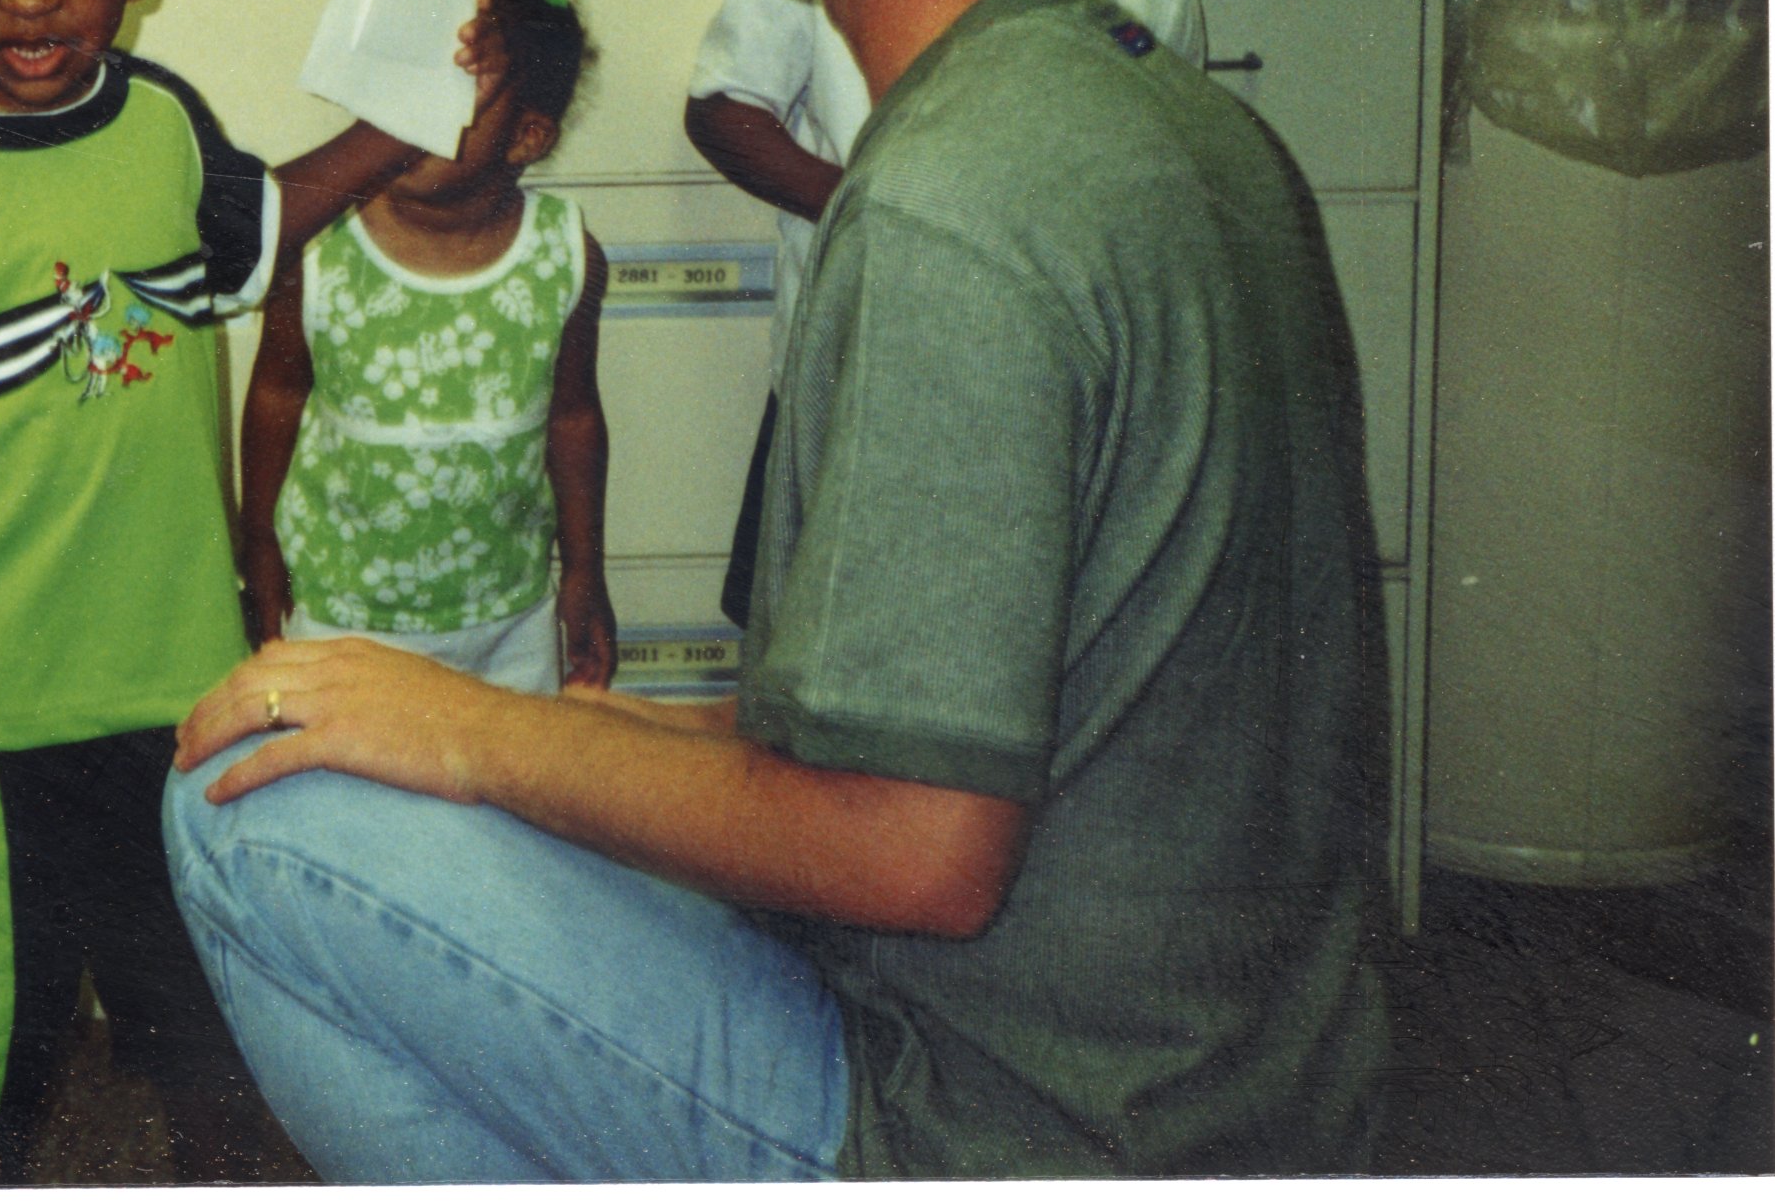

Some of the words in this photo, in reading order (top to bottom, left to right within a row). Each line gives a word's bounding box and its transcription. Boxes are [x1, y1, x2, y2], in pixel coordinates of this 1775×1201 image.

[618, 268, 658, 283] 2881
[683, 268, 725, 283] 3010
[683, 646, 725, 662] 3100
